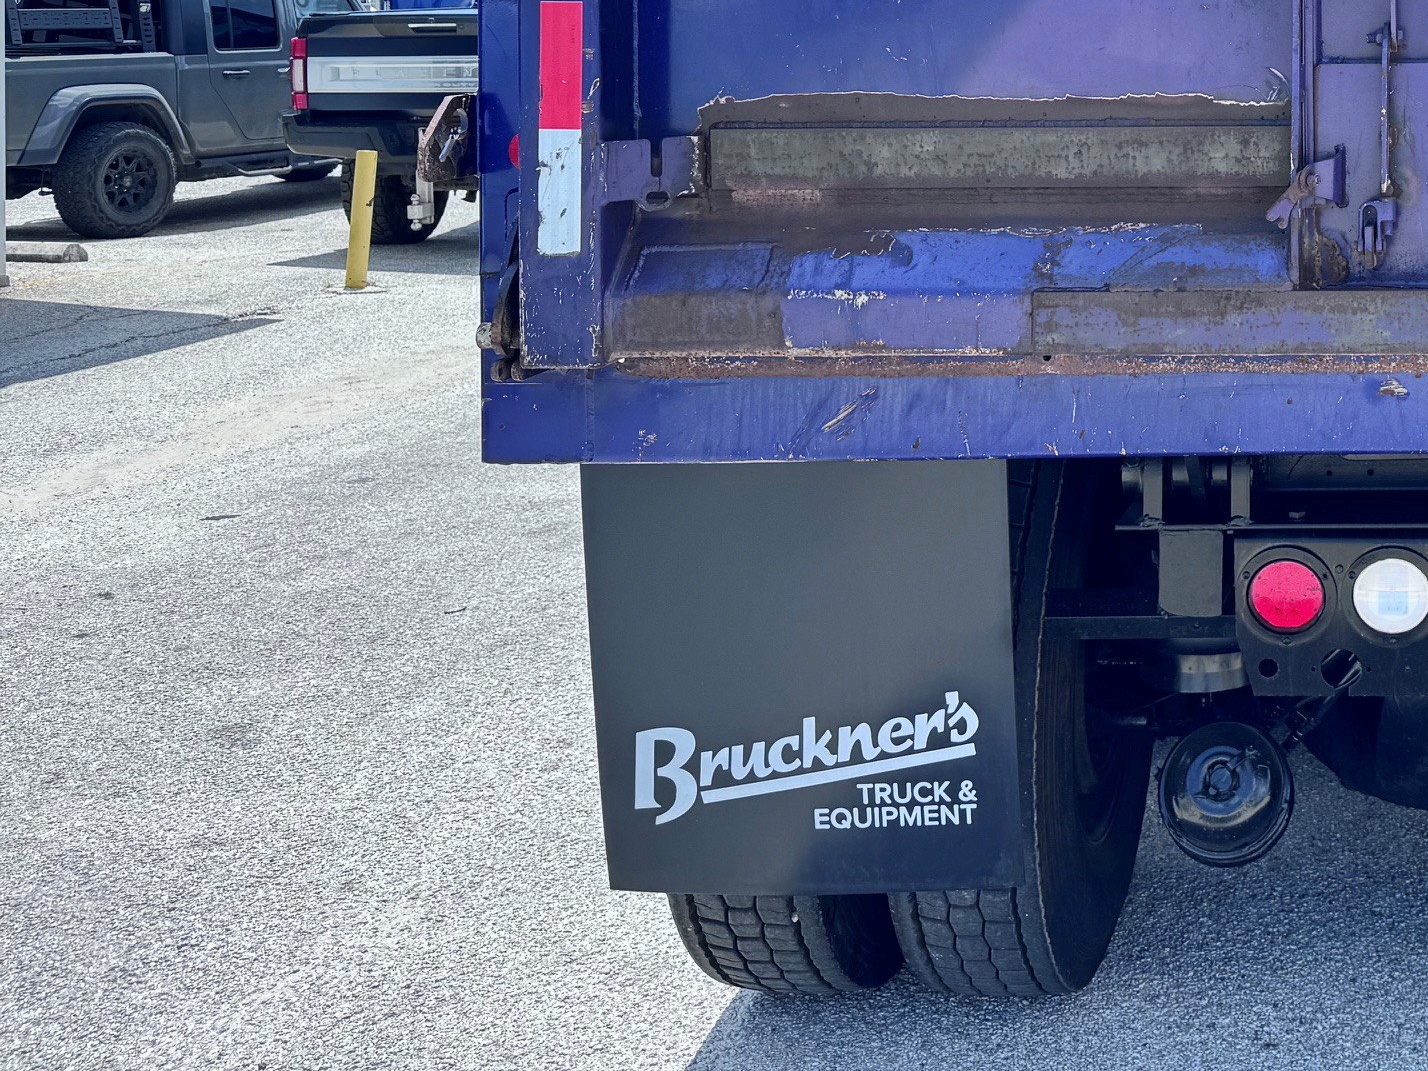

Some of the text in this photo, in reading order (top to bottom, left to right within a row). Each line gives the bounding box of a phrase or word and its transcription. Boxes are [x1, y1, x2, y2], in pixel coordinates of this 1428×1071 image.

[634, 690, 980, 826] Bruckner's
[857, 779, 978, 805] TRUCK &
[813, 803, 978, 830] EQUIPMENT
